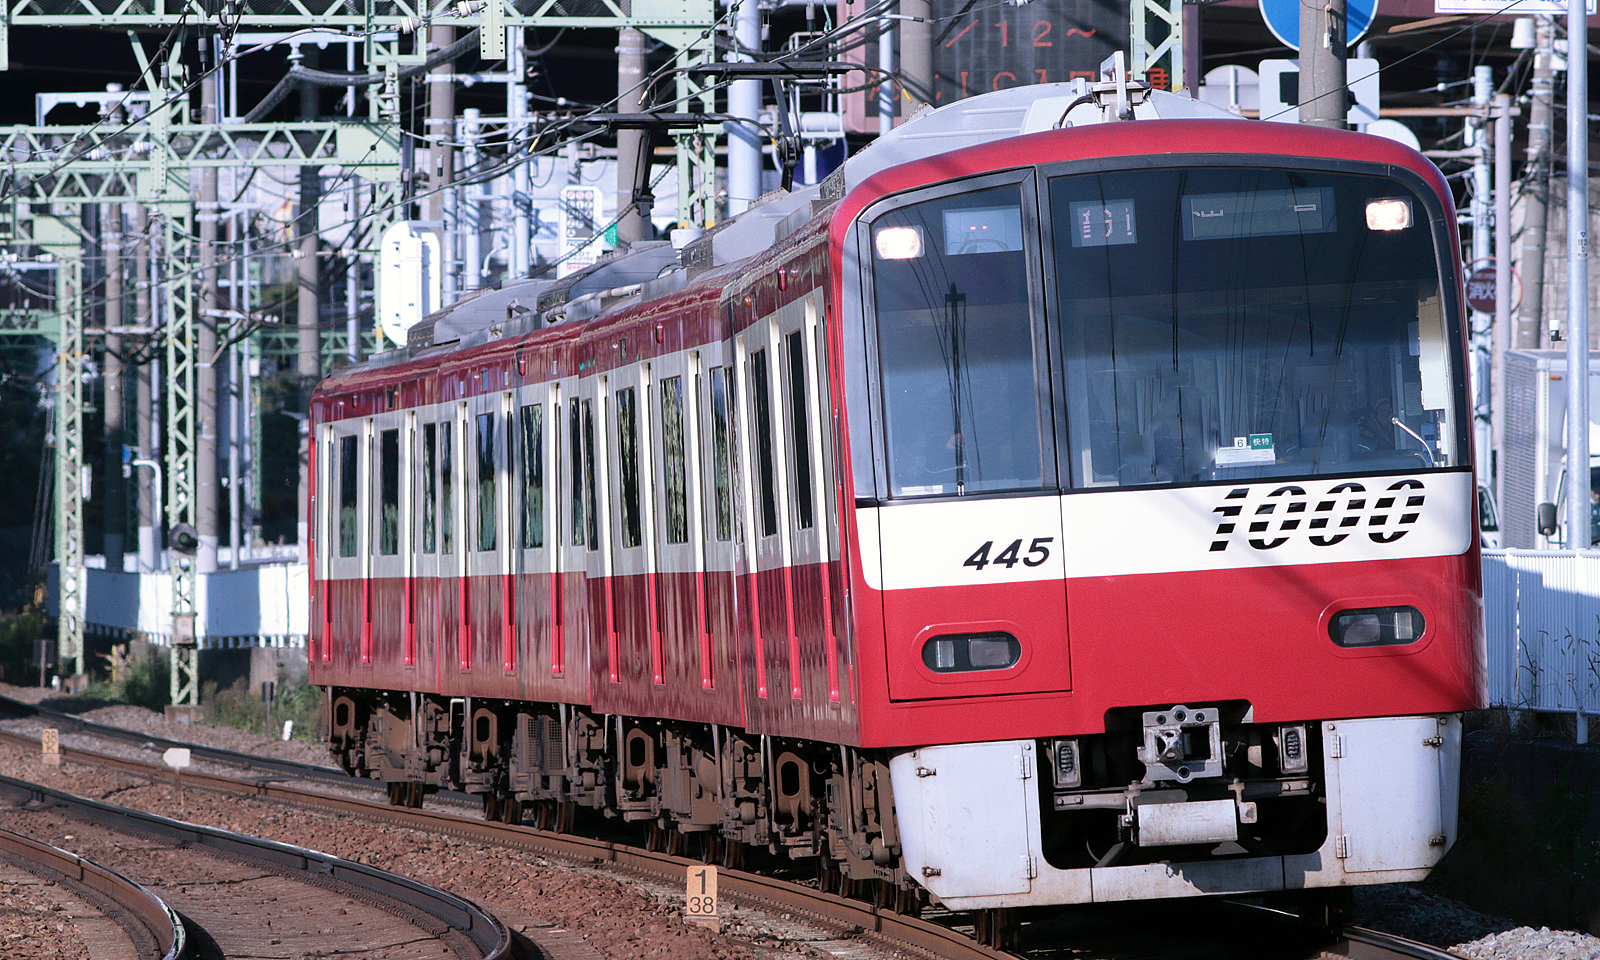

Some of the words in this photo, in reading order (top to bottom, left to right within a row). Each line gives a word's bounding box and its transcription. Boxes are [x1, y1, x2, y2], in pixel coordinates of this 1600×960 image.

[1469, 281, 1496, 300] 消火
[1237, 438, 1244, 447] 6
[1209, 479, 1425, 552] 1000
[963, 537, 1054, 570] 445
[44, 730, 56, 744] 38
[695, 869, 706, 894] 1
[690, 896, 714, 913] 38
